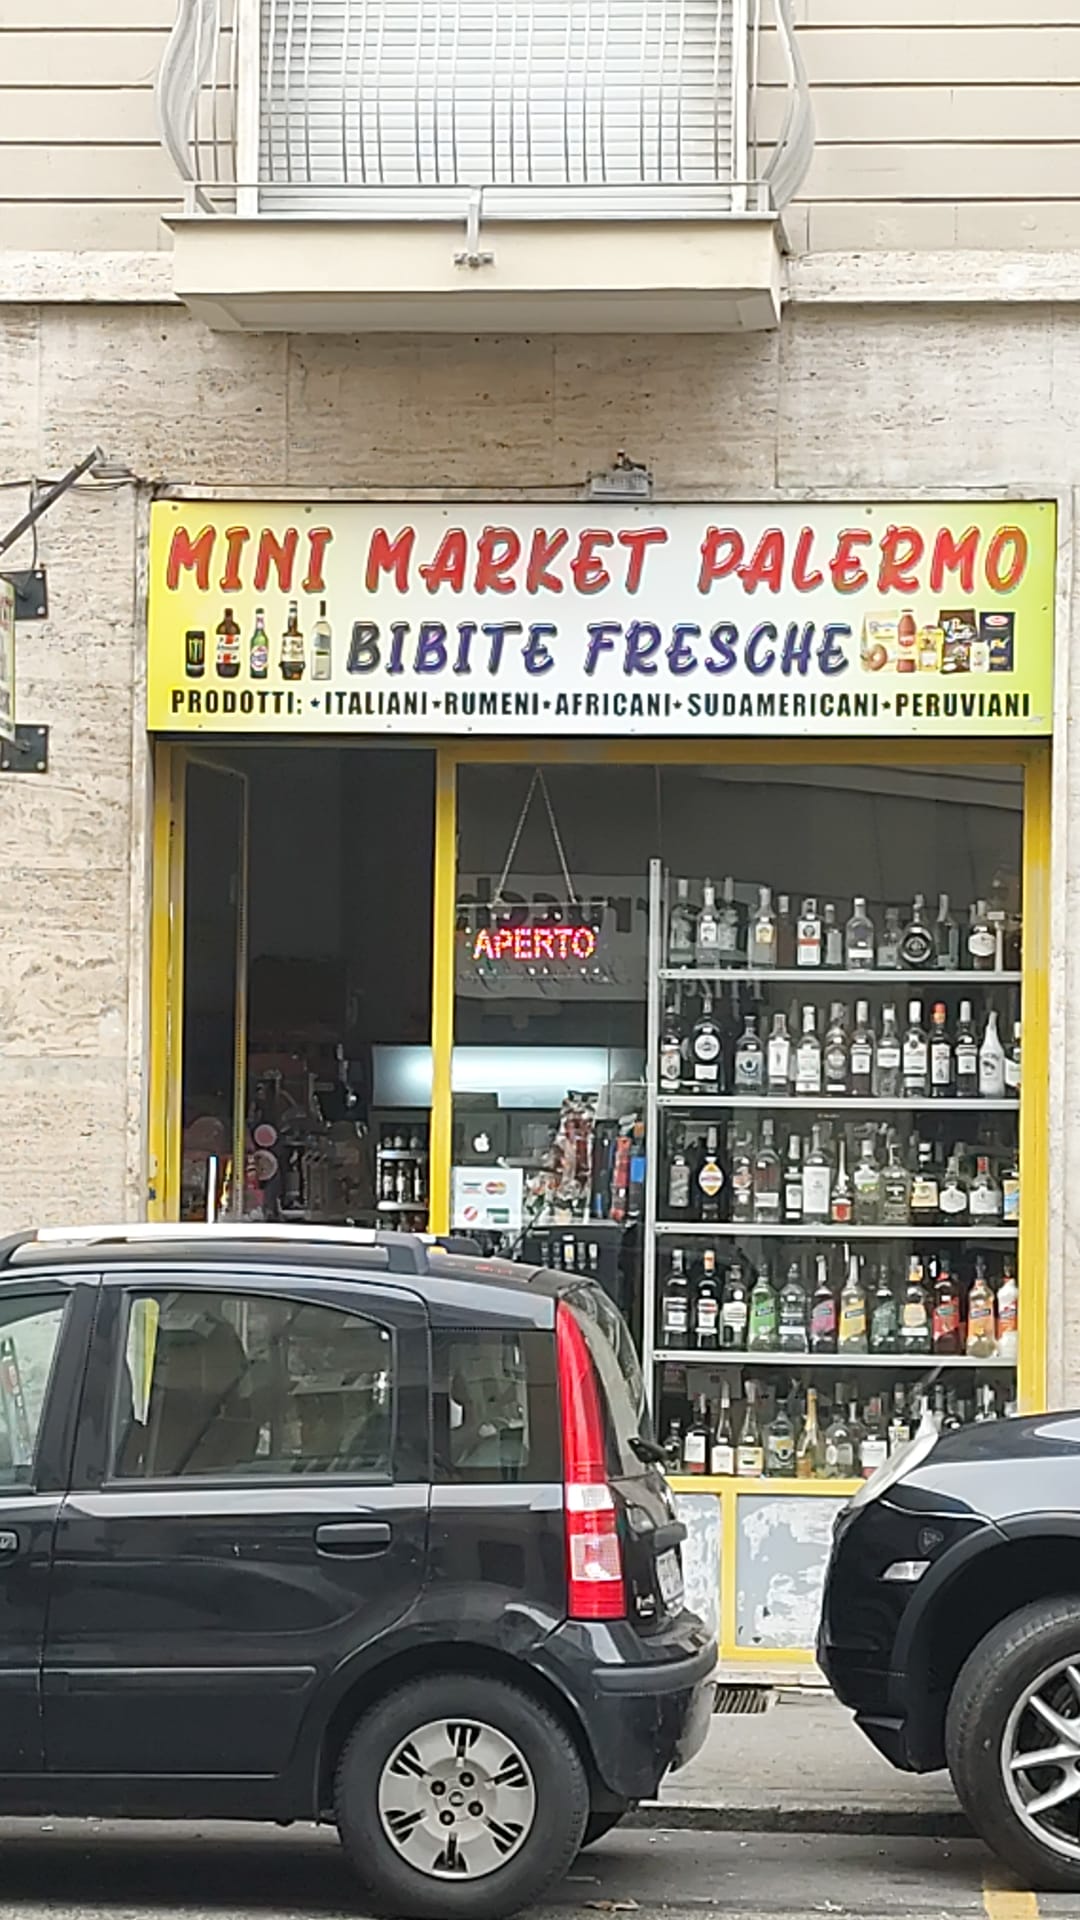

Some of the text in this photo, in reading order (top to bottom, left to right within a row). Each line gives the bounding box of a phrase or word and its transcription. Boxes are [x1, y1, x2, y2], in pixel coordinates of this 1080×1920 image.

[166, 524, 1028, 596] MINI MARKET PALERMO
[346, 620, 851, 677] BIBITE FRESCHE
[171, 690, 1030, 717] PRODOTTI: ITALIANI RUMENI AFRICANI SUDAMERICANI PERUVIANI
[472, 927, 596, 961] APERTO
